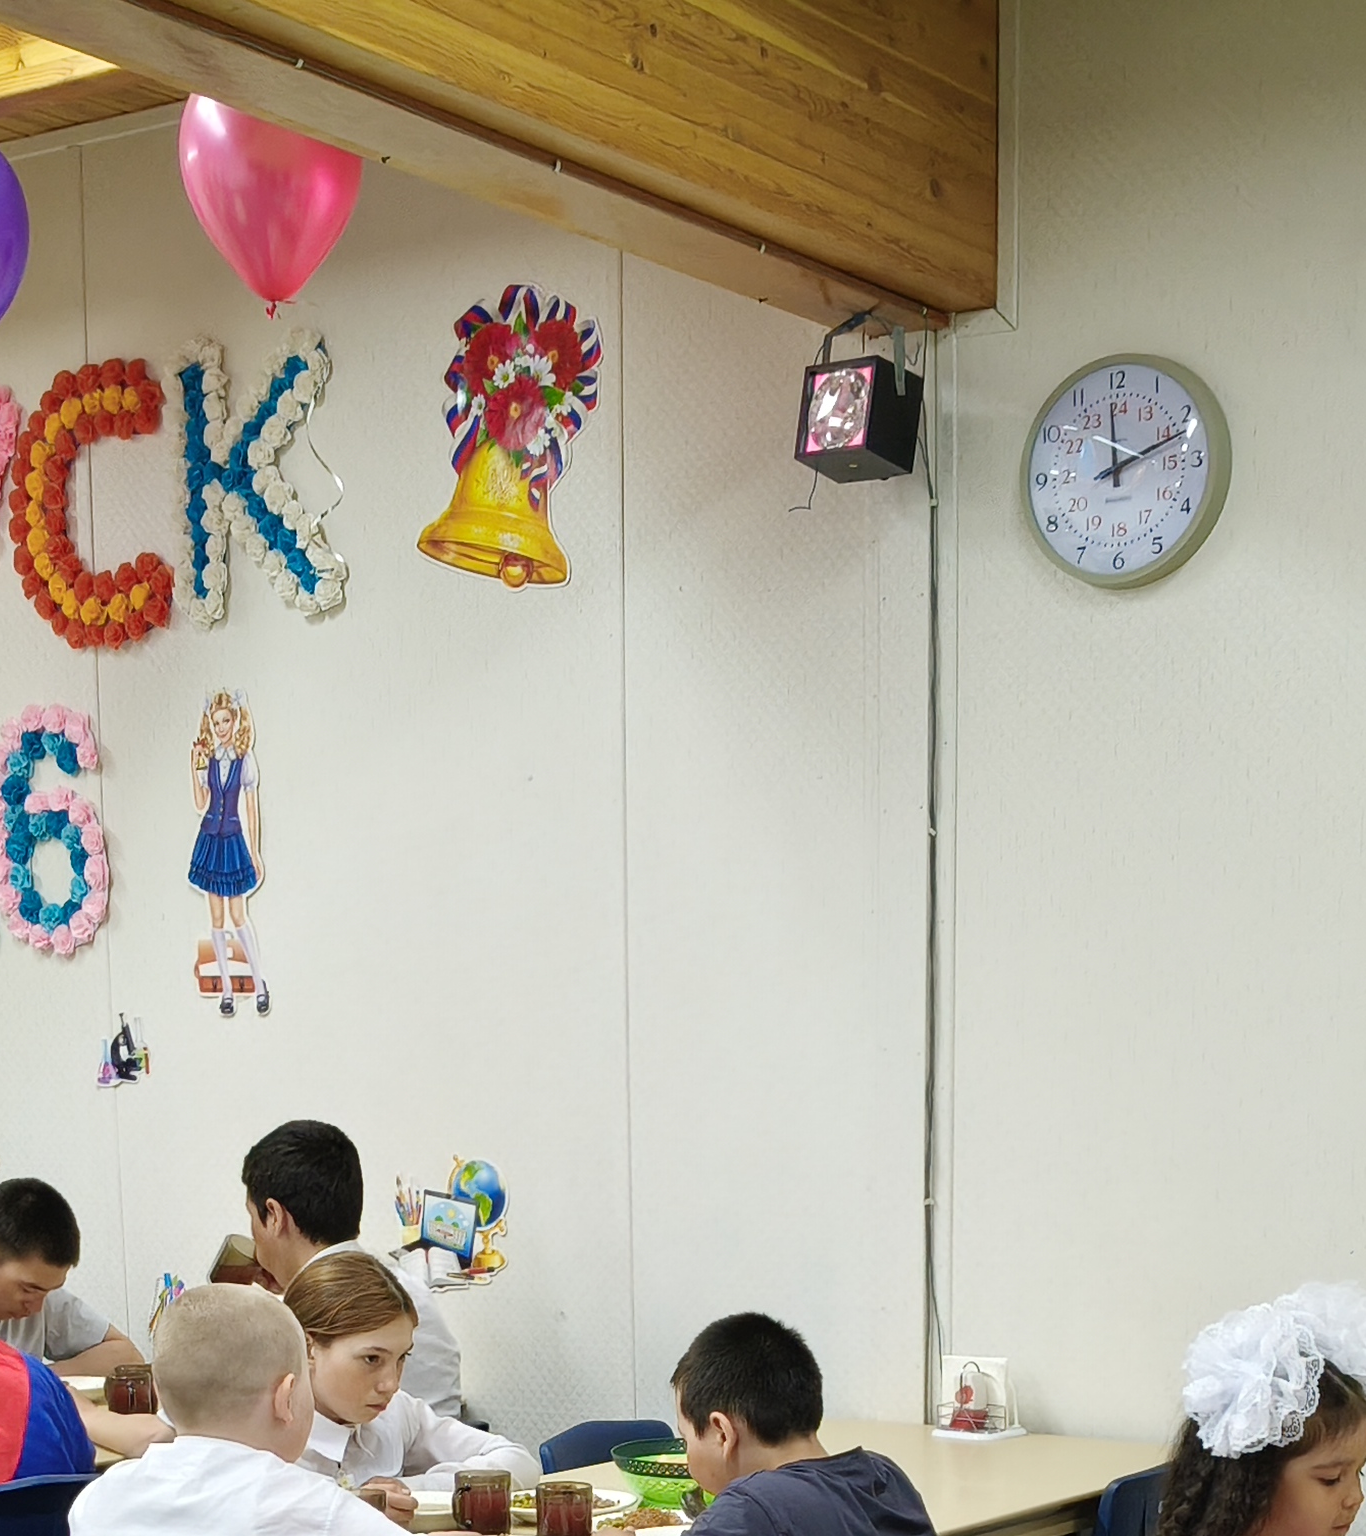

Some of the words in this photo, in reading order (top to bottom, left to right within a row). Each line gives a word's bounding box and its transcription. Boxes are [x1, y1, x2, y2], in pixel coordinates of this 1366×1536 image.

[1110, 370, 1125, 389] 12
[1073, 387, 1084, 407] 11
[1110, 401, 1128, 417] 24
[1138, 405, 1153, 422] 13
[1180, 404, 1191, 423] 2
[1082, 413, 1102, 430] 23
[1043, 425, 1060, 444] 10
[1157, 424, 1171, 441] 14
[1065, 438, 1084, 454] 22
[1163, 454, 1178, 471] 15
[1190, 449, 1203, 468] 3
[1035, 472, 1047, 491] 9
[1157, 486, 1173, 501] 16
[1068, 496, 1087, 512] 20
[1180, 497, 1191, 515] 4
[1046, 514, 1058, 532] 8
[1086, 515, 1102, 531] 19
[1139, 508, 1152, 525] 17
[1111, 522, 1127, 537] 18
[1151, 536, 1163, 554] 5
[1077, 545, 1086, 564] 7
[1112, 551, 1125, 570] 6
